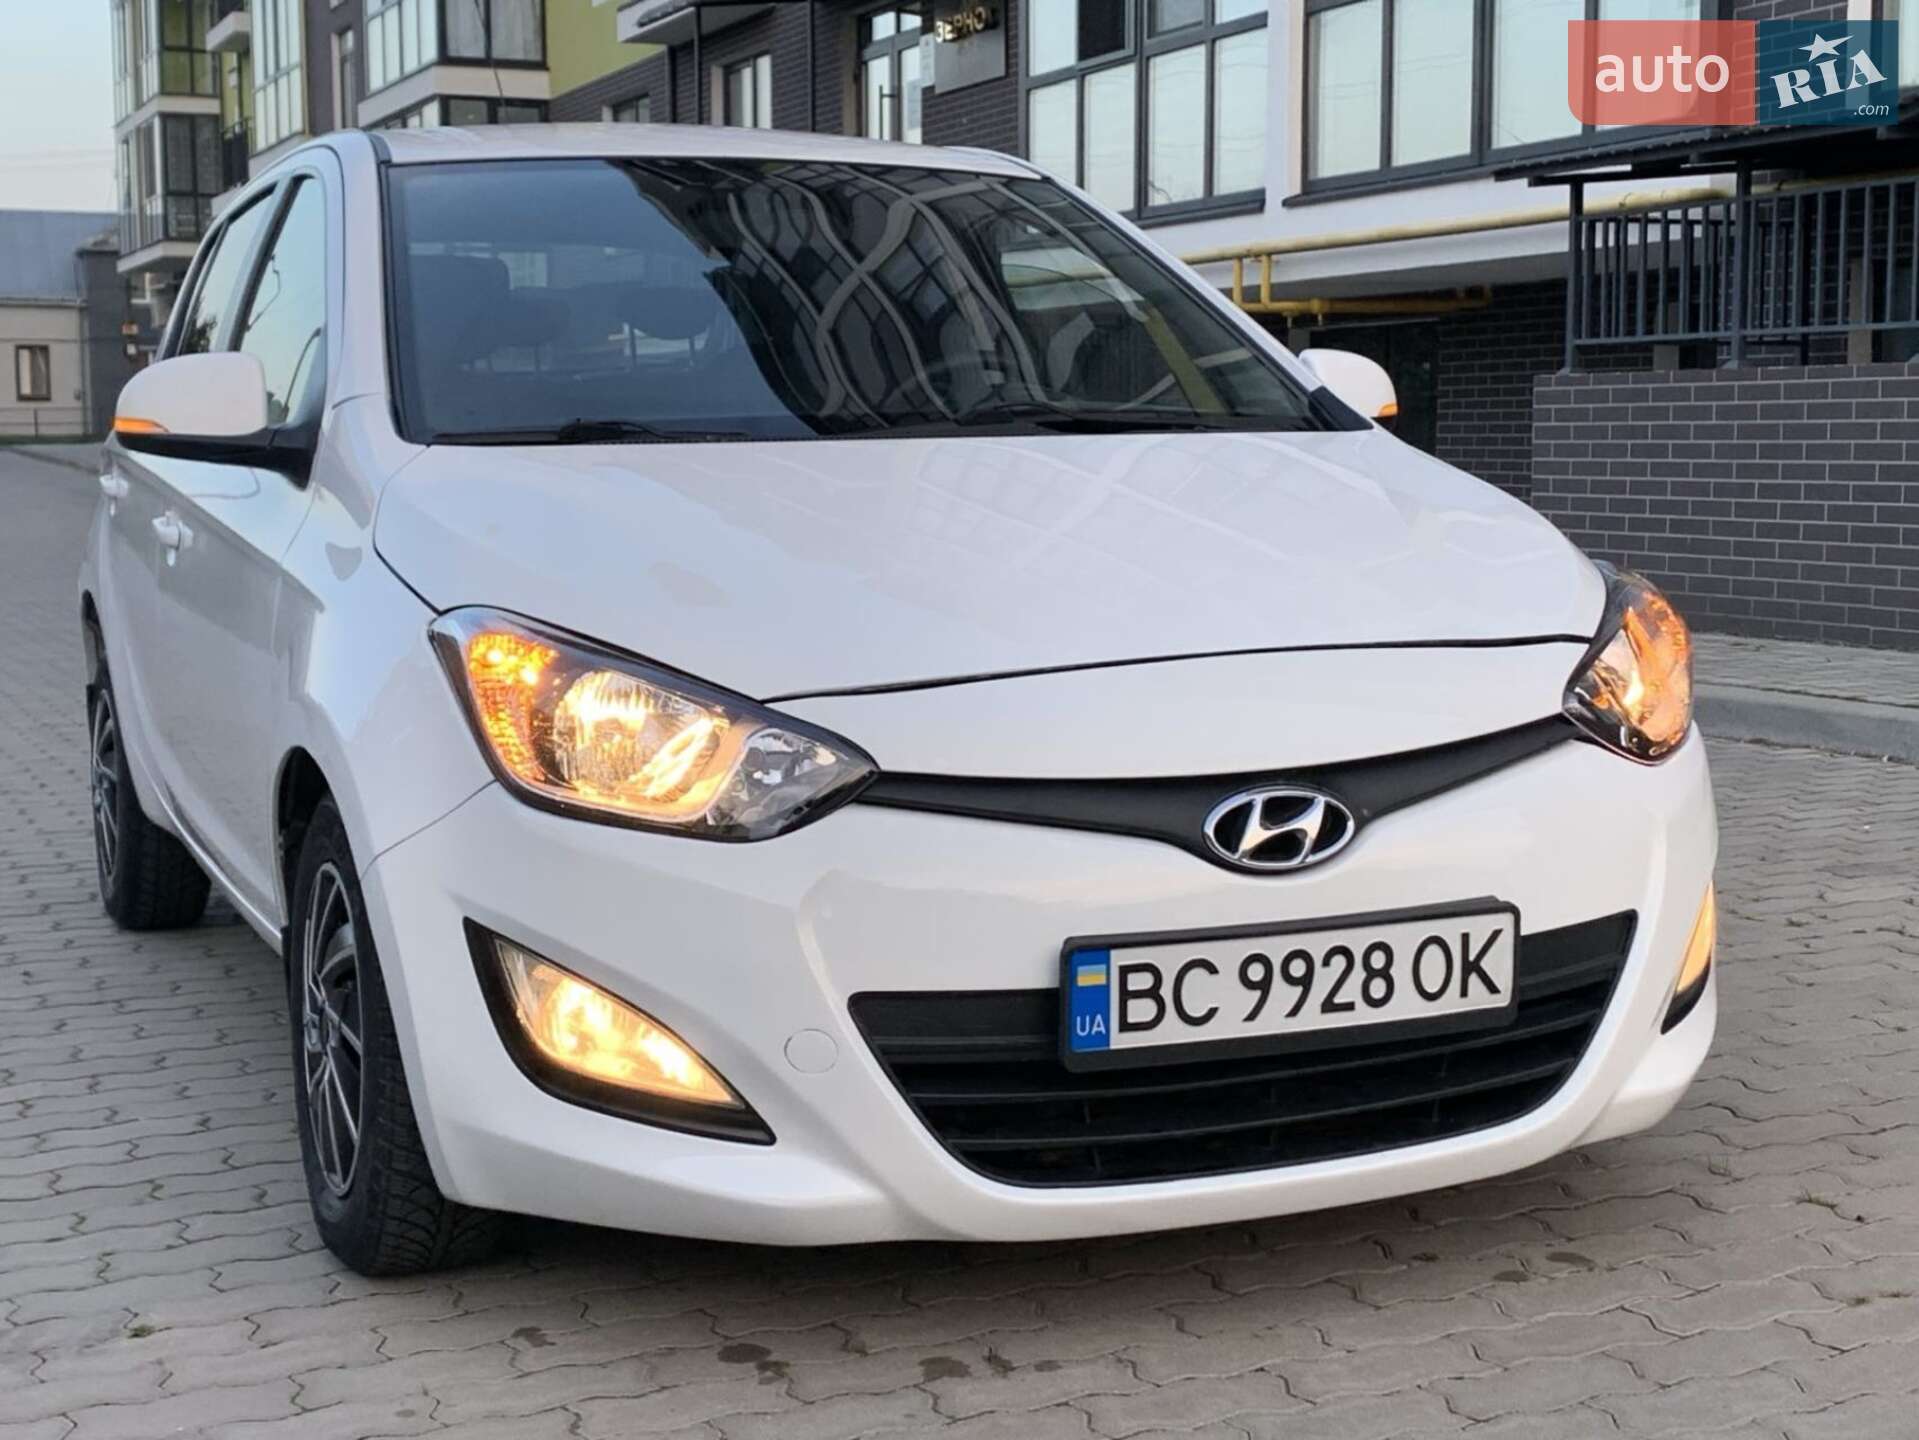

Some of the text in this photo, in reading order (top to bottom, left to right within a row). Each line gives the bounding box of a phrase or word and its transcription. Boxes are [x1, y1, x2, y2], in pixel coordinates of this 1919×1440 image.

[1118, 928, 1504, 1034] BC 9928 OK
[1076, 1014, 1106, 1036] UA
